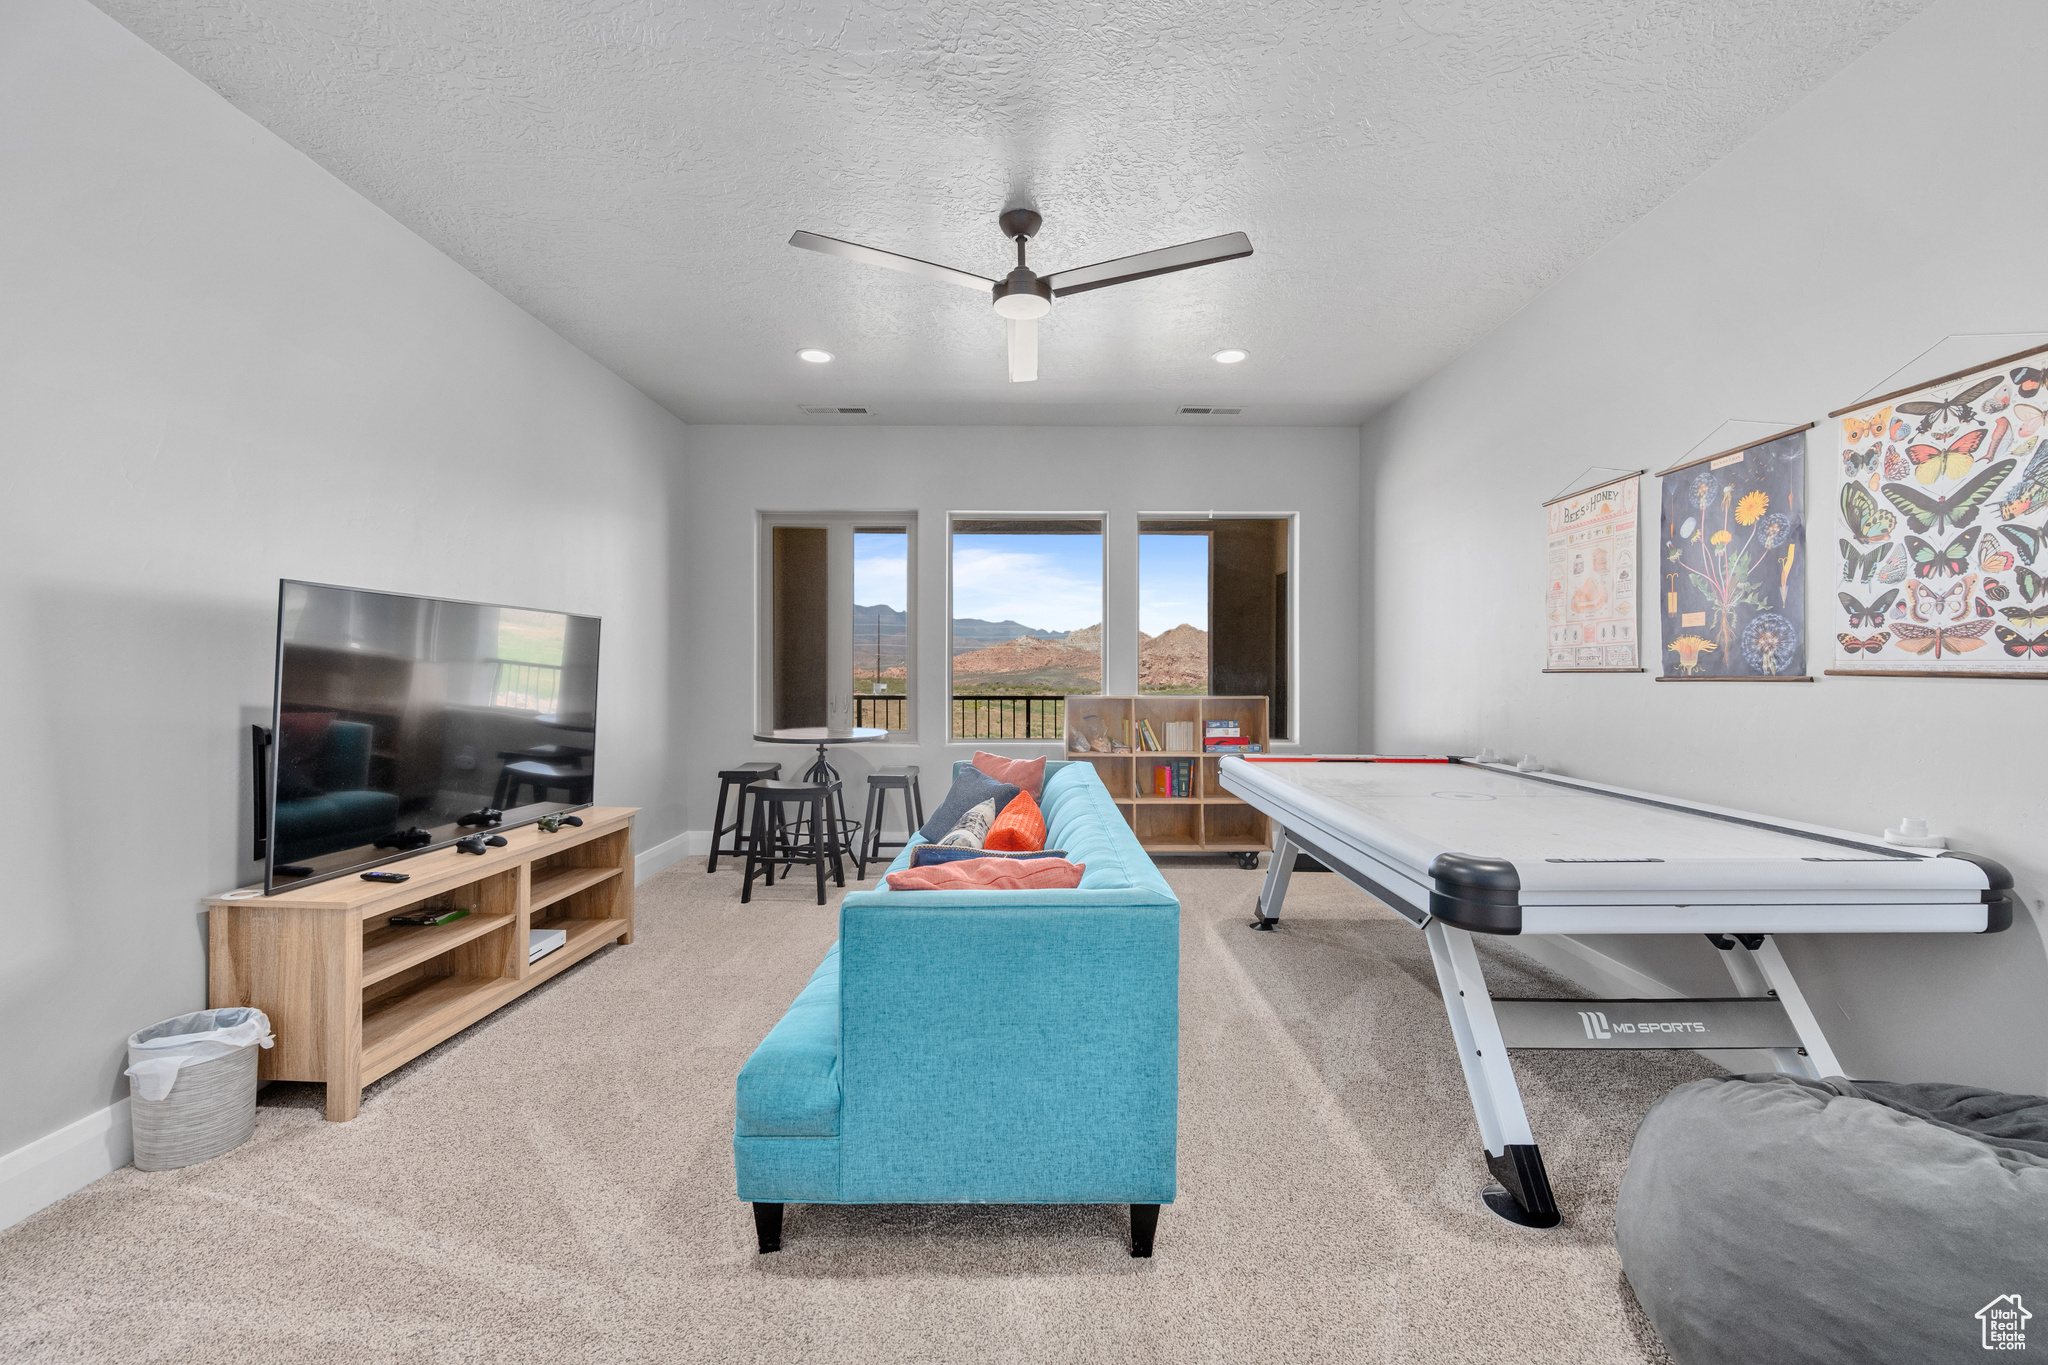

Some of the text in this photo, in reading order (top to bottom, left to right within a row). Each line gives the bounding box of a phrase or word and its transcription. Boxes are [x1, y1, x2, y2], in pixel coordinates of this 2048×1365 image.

[1563, 505, 1585, 523] BEES
[1590, 490, 1619, 513] HONEY
[1612, 1022, 1706, 1033] MD SPORTS
